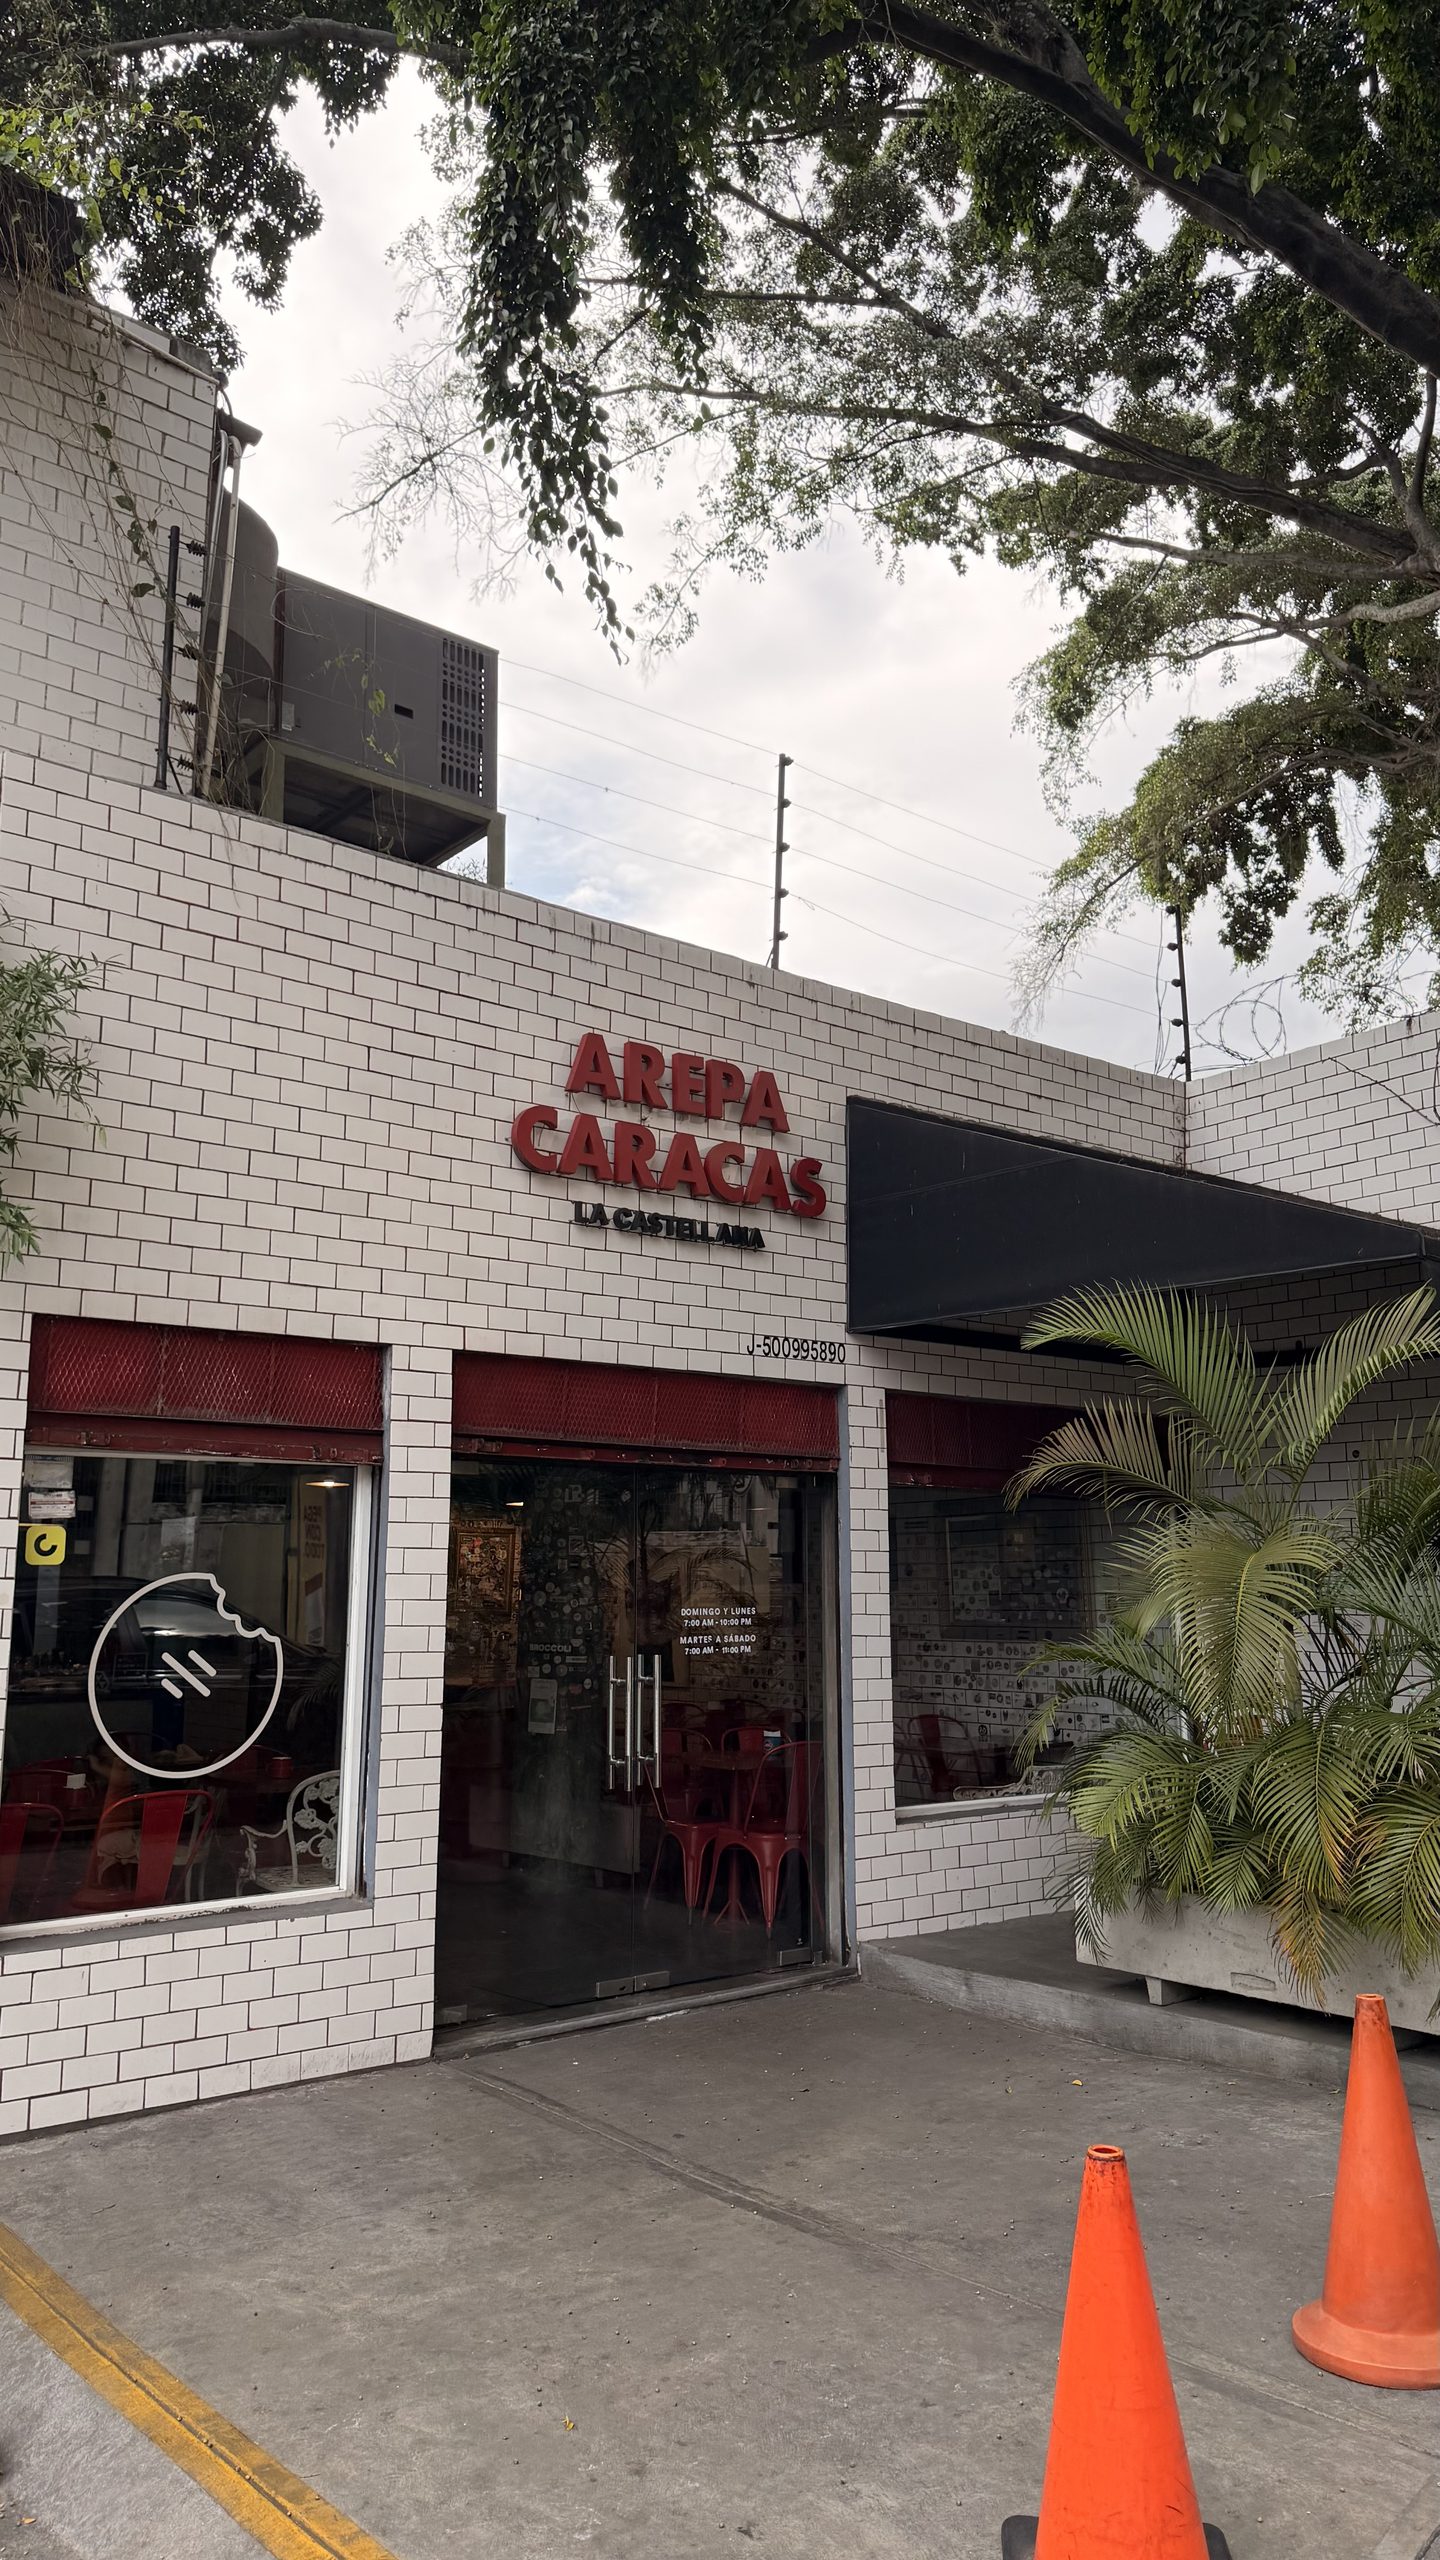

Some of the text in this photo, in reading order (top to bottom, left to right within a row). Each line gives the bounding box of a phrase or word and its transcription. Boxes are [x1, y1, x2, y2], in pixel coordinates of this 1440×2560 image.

[564, 1032, 790, 1133] AREPA
[511, 1105, 827, 1218] CARACAS
[573, 1200, 766, 1249] LA CASTELLANA
[746, 1334, 846, 1363] J-500995890
[681, 1607, 756, 1616] DOMINGO Y LUNES
[684, 1619, 700, 1627] 7:00
[702, 1618, 714, 1626] AM
[720, 1618, 739, 1626] 10:00
[740, 1617, 752, 1626] PM
[680, 1633, 756, 1644] MARTES A SÁBADO
[684, 1647, 700, 1655] 7:00
[702, 1645, 714, 1654] AM
[722, 1646, 739, 1654] 11:00
[740, 1645, 751, 1653] PM
